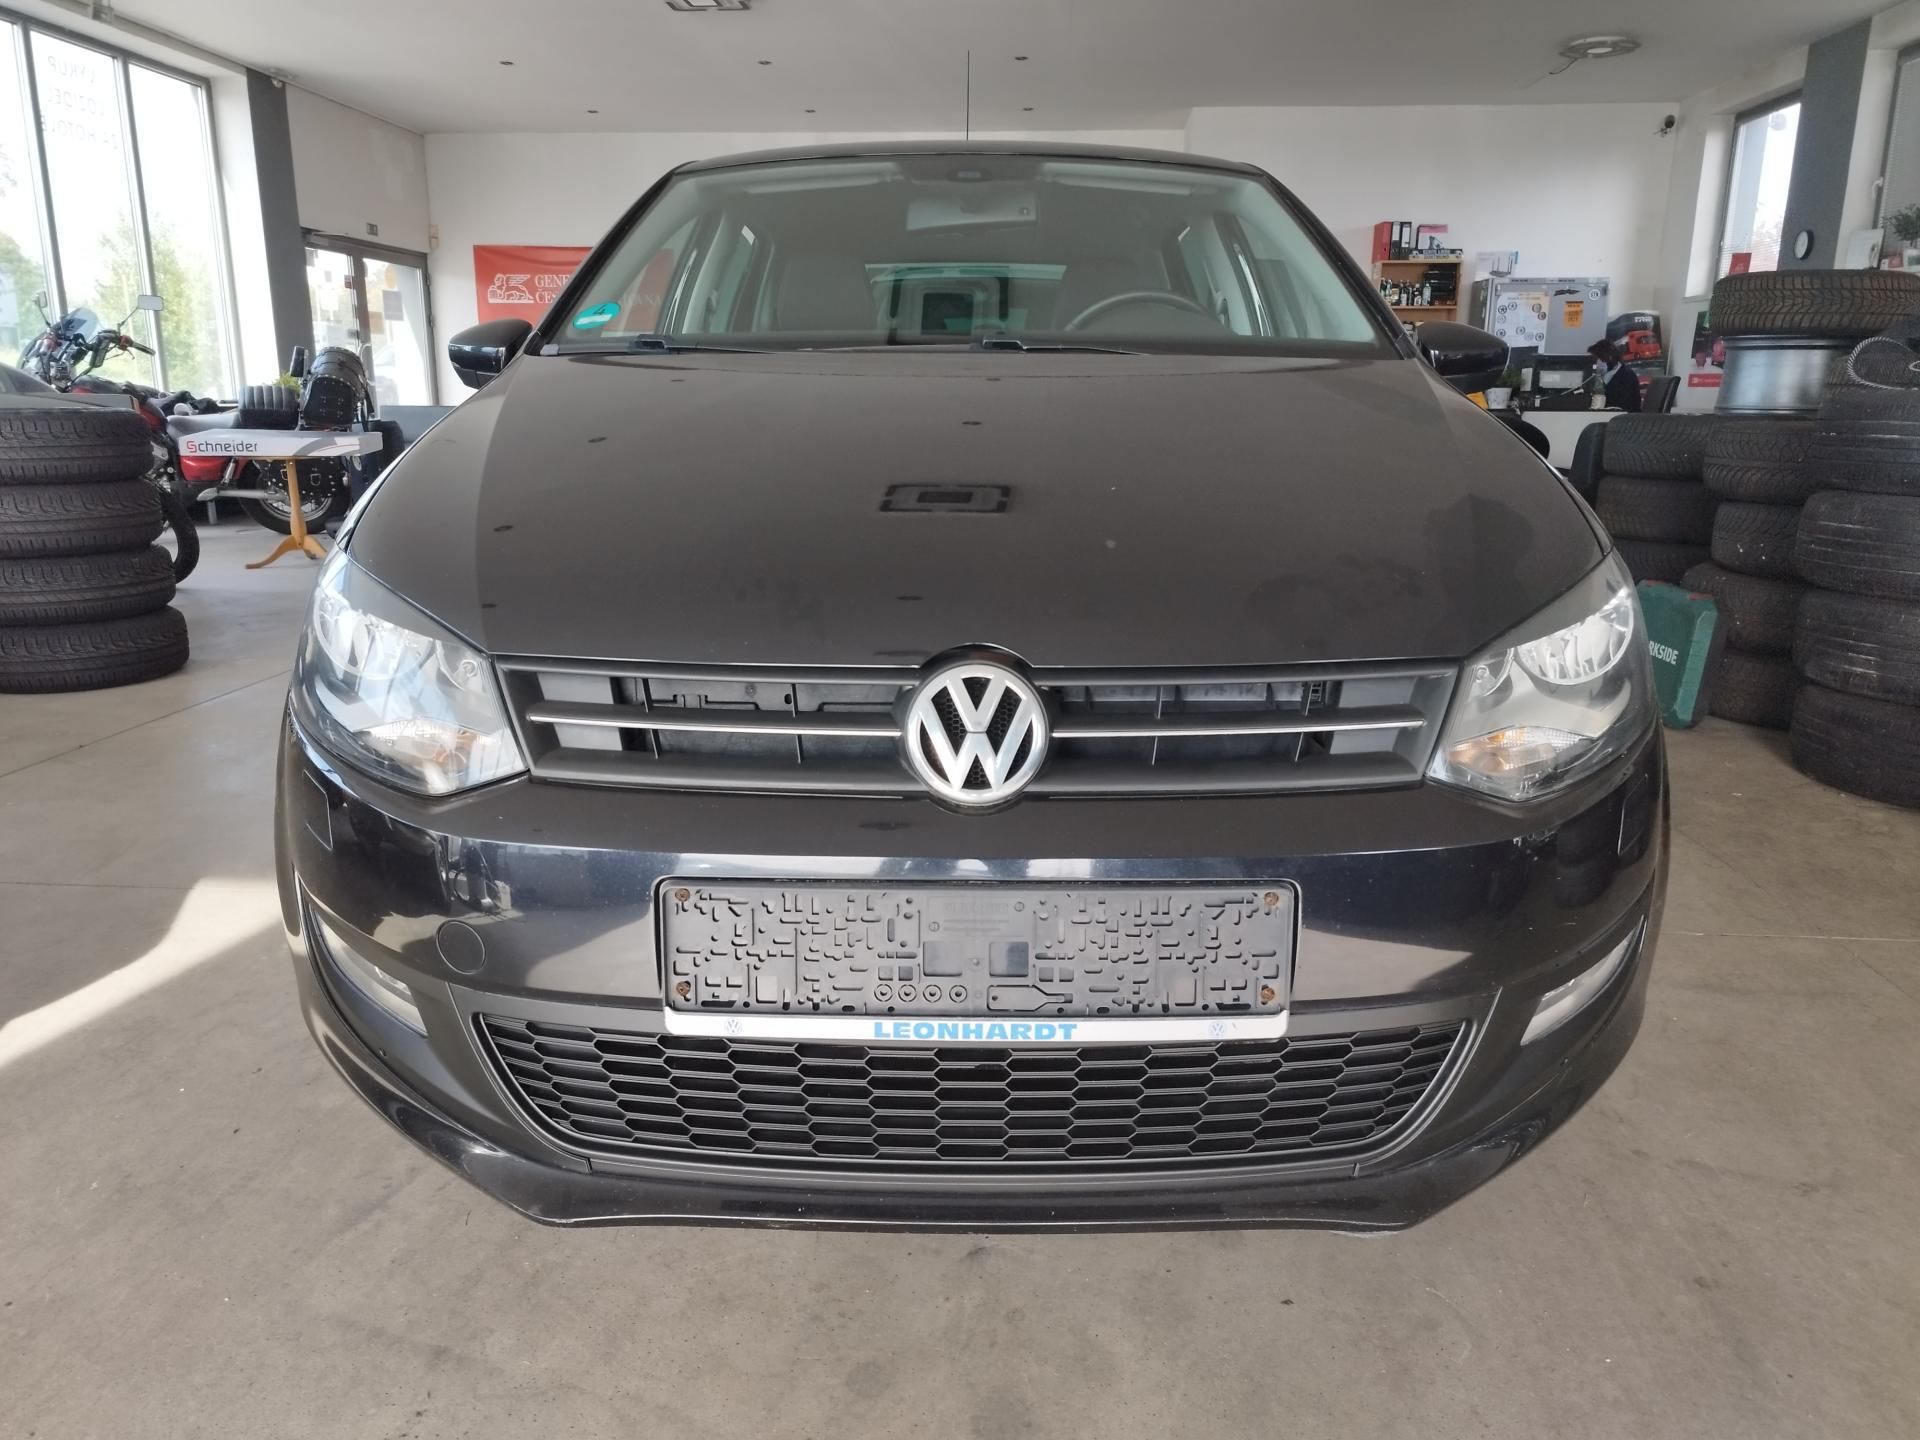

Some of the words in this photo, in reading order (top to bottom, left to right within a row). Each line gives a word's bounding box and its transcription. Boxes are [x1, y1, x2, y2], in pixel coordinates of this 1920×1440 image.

[592, 303, 609, 315] 4
[186, 440, 258, 454] Schneider
[873, 1021, 1078, 1041] LEONHARDT
